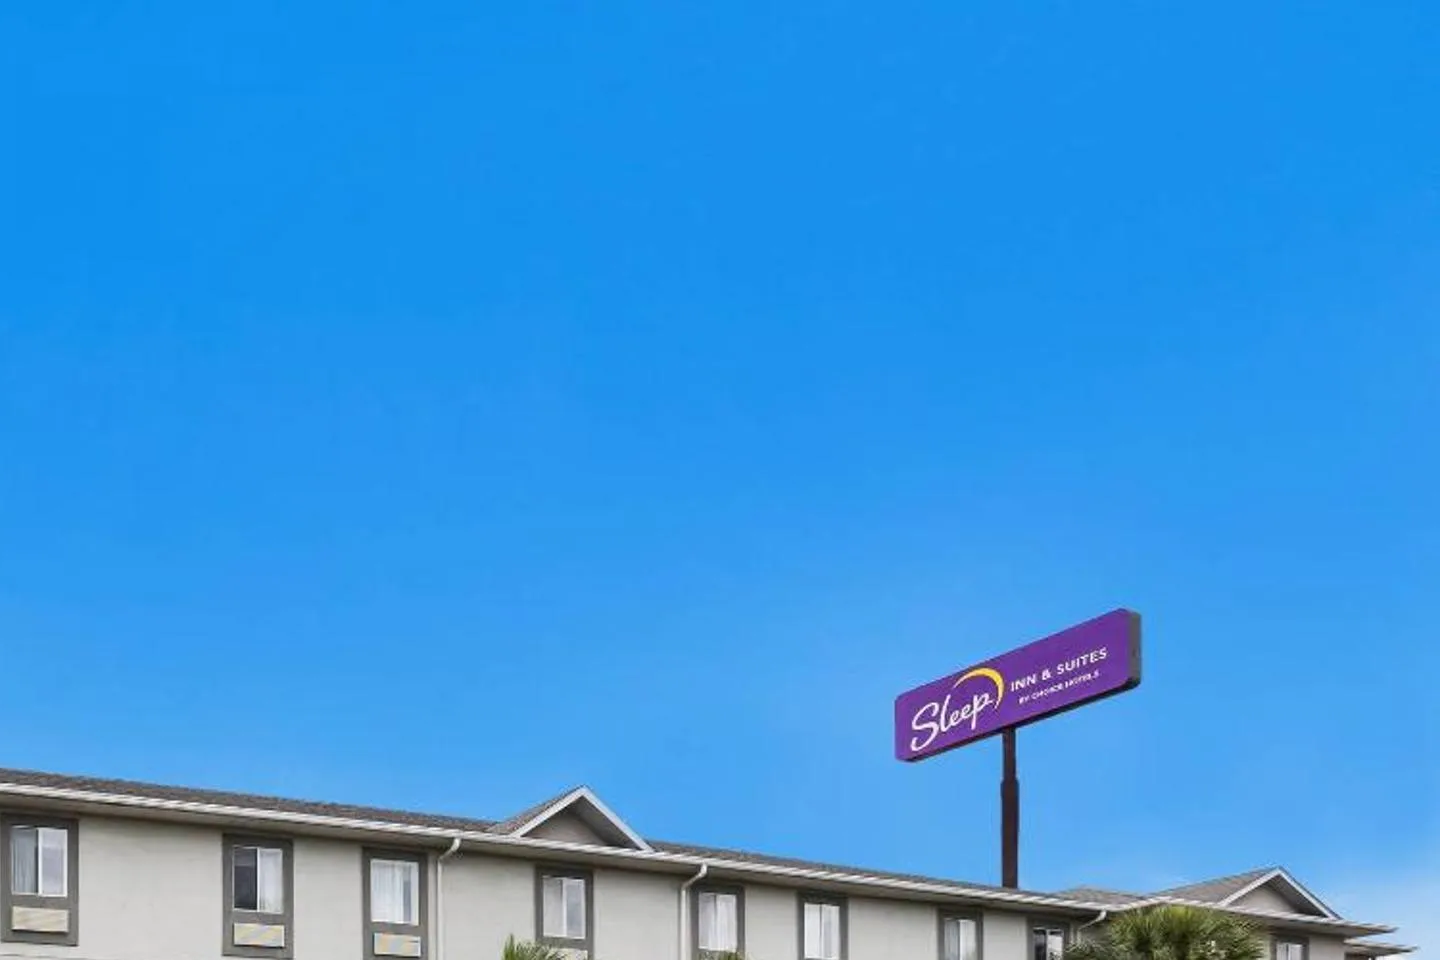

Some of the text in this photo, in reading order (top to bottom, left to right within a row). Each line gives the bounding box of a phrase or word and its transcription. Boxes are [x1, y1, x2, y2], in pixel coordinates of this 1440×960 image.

[1010, 646, 1108, 692] INN & SUITES
[910, 693, 995, 752] Sleep
